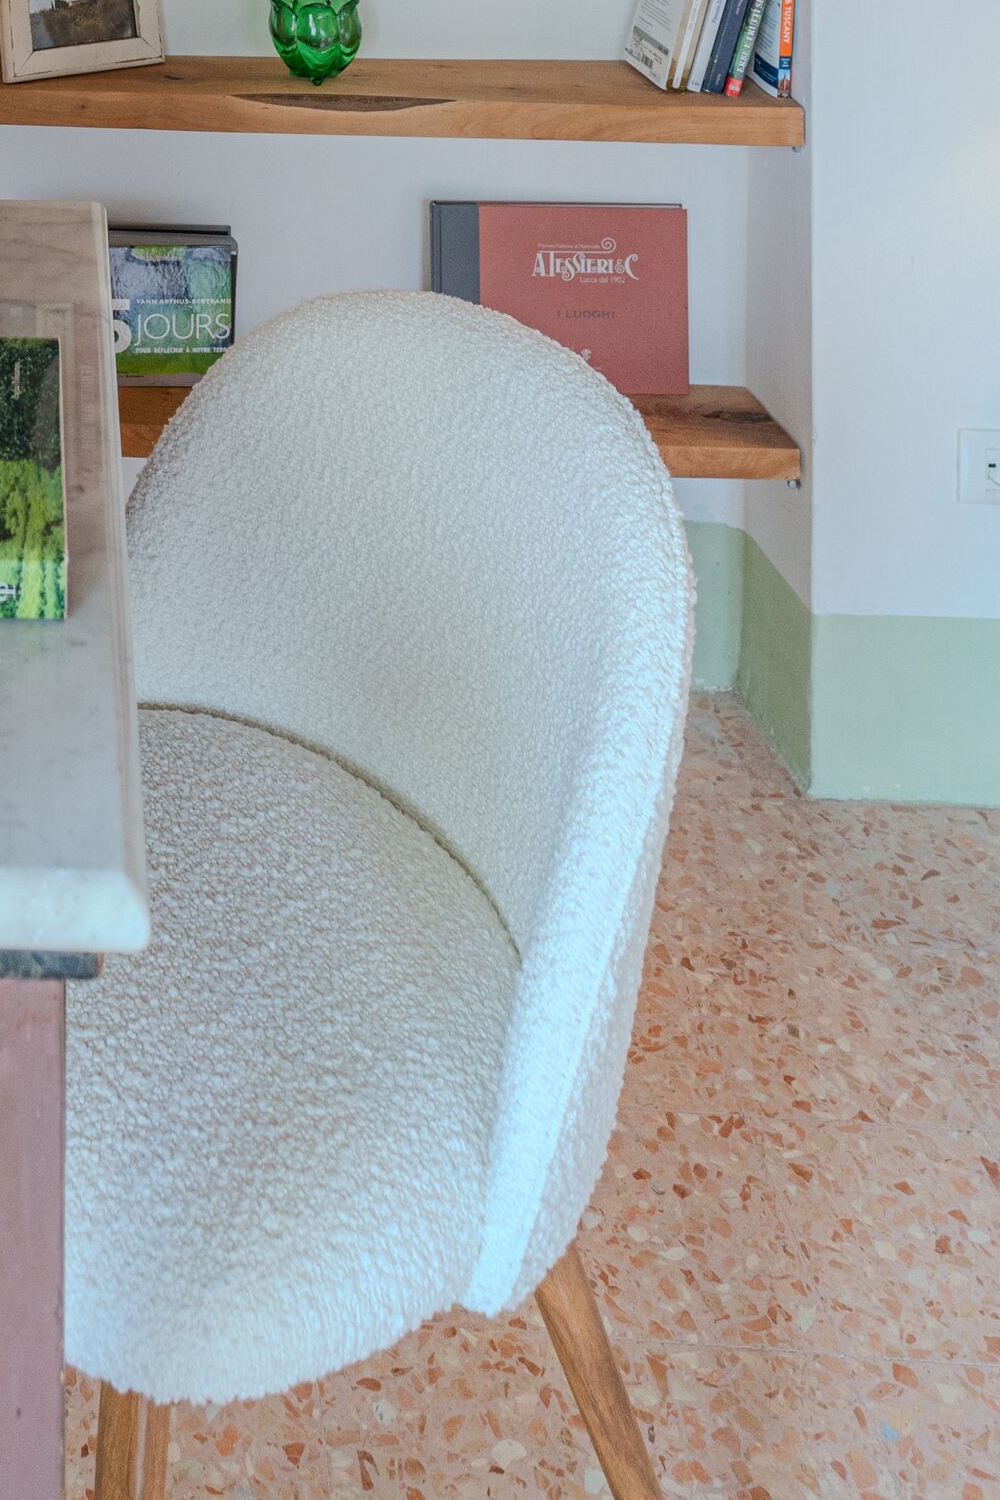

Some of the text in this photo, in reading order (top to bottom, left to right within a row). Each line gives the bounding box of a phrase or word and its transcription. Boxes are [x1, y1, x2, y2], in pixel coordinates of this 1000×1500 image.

[783, 6, 793, 44] TUSCANY
[737, 51, 749, 74] ERBE
[133, 313, 231, 346] JOURS
